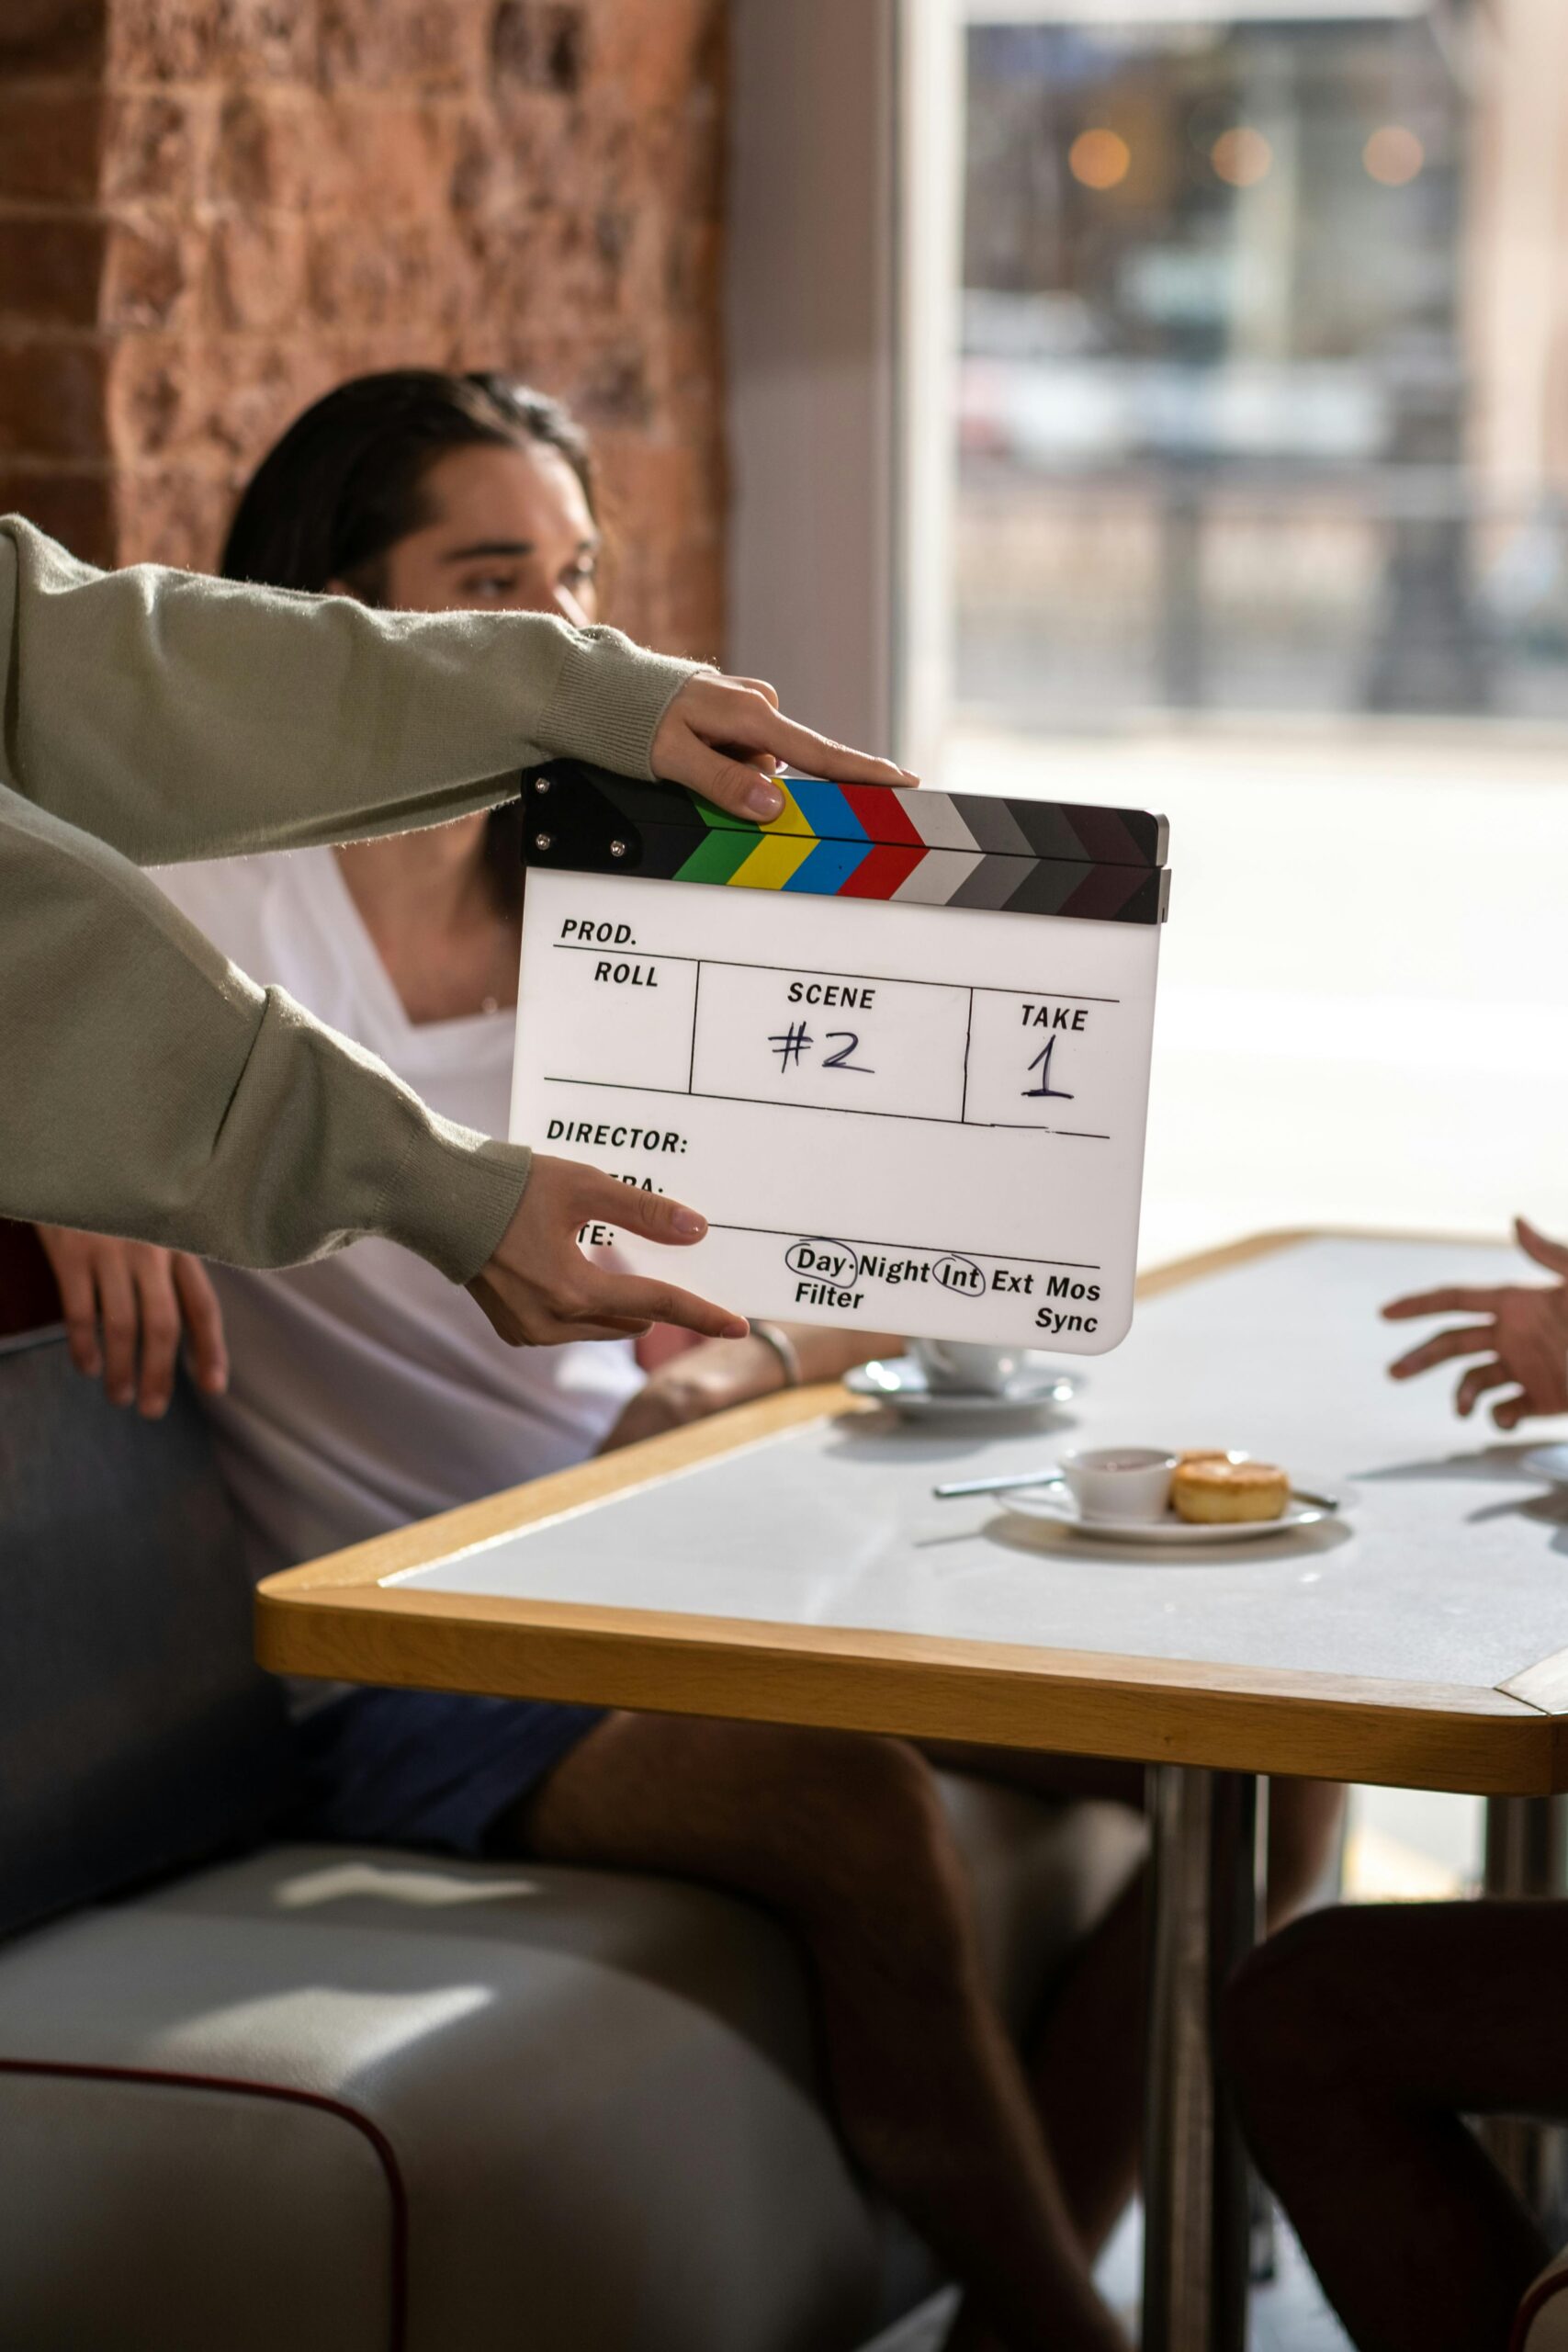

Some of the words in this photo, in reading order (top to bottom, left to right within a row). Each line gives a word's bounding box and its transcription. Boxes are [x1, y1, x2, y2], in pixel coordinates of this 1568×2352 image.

[560, 919, 637, 945] PROD.
[594, 961, 659, 988] ROLL
[787, 981, 876, 1010] SCENE
[1021, 1004, 1089, 1032] TAKE
[1021, 1034, 1075, 1100] 1
[547, 1119, 688, 1154] DIRECTOR:
[578, 1224, 615, 1247] TE:
[795, 1282, 864, 1309] Filter
[942, 1264, 980, 1289] Int
[991, 1270, 1034, 1295] Ext
[1046, 1275, 1100, 1302] Mos
[1035, 1307, 1099, 1334] Sync
